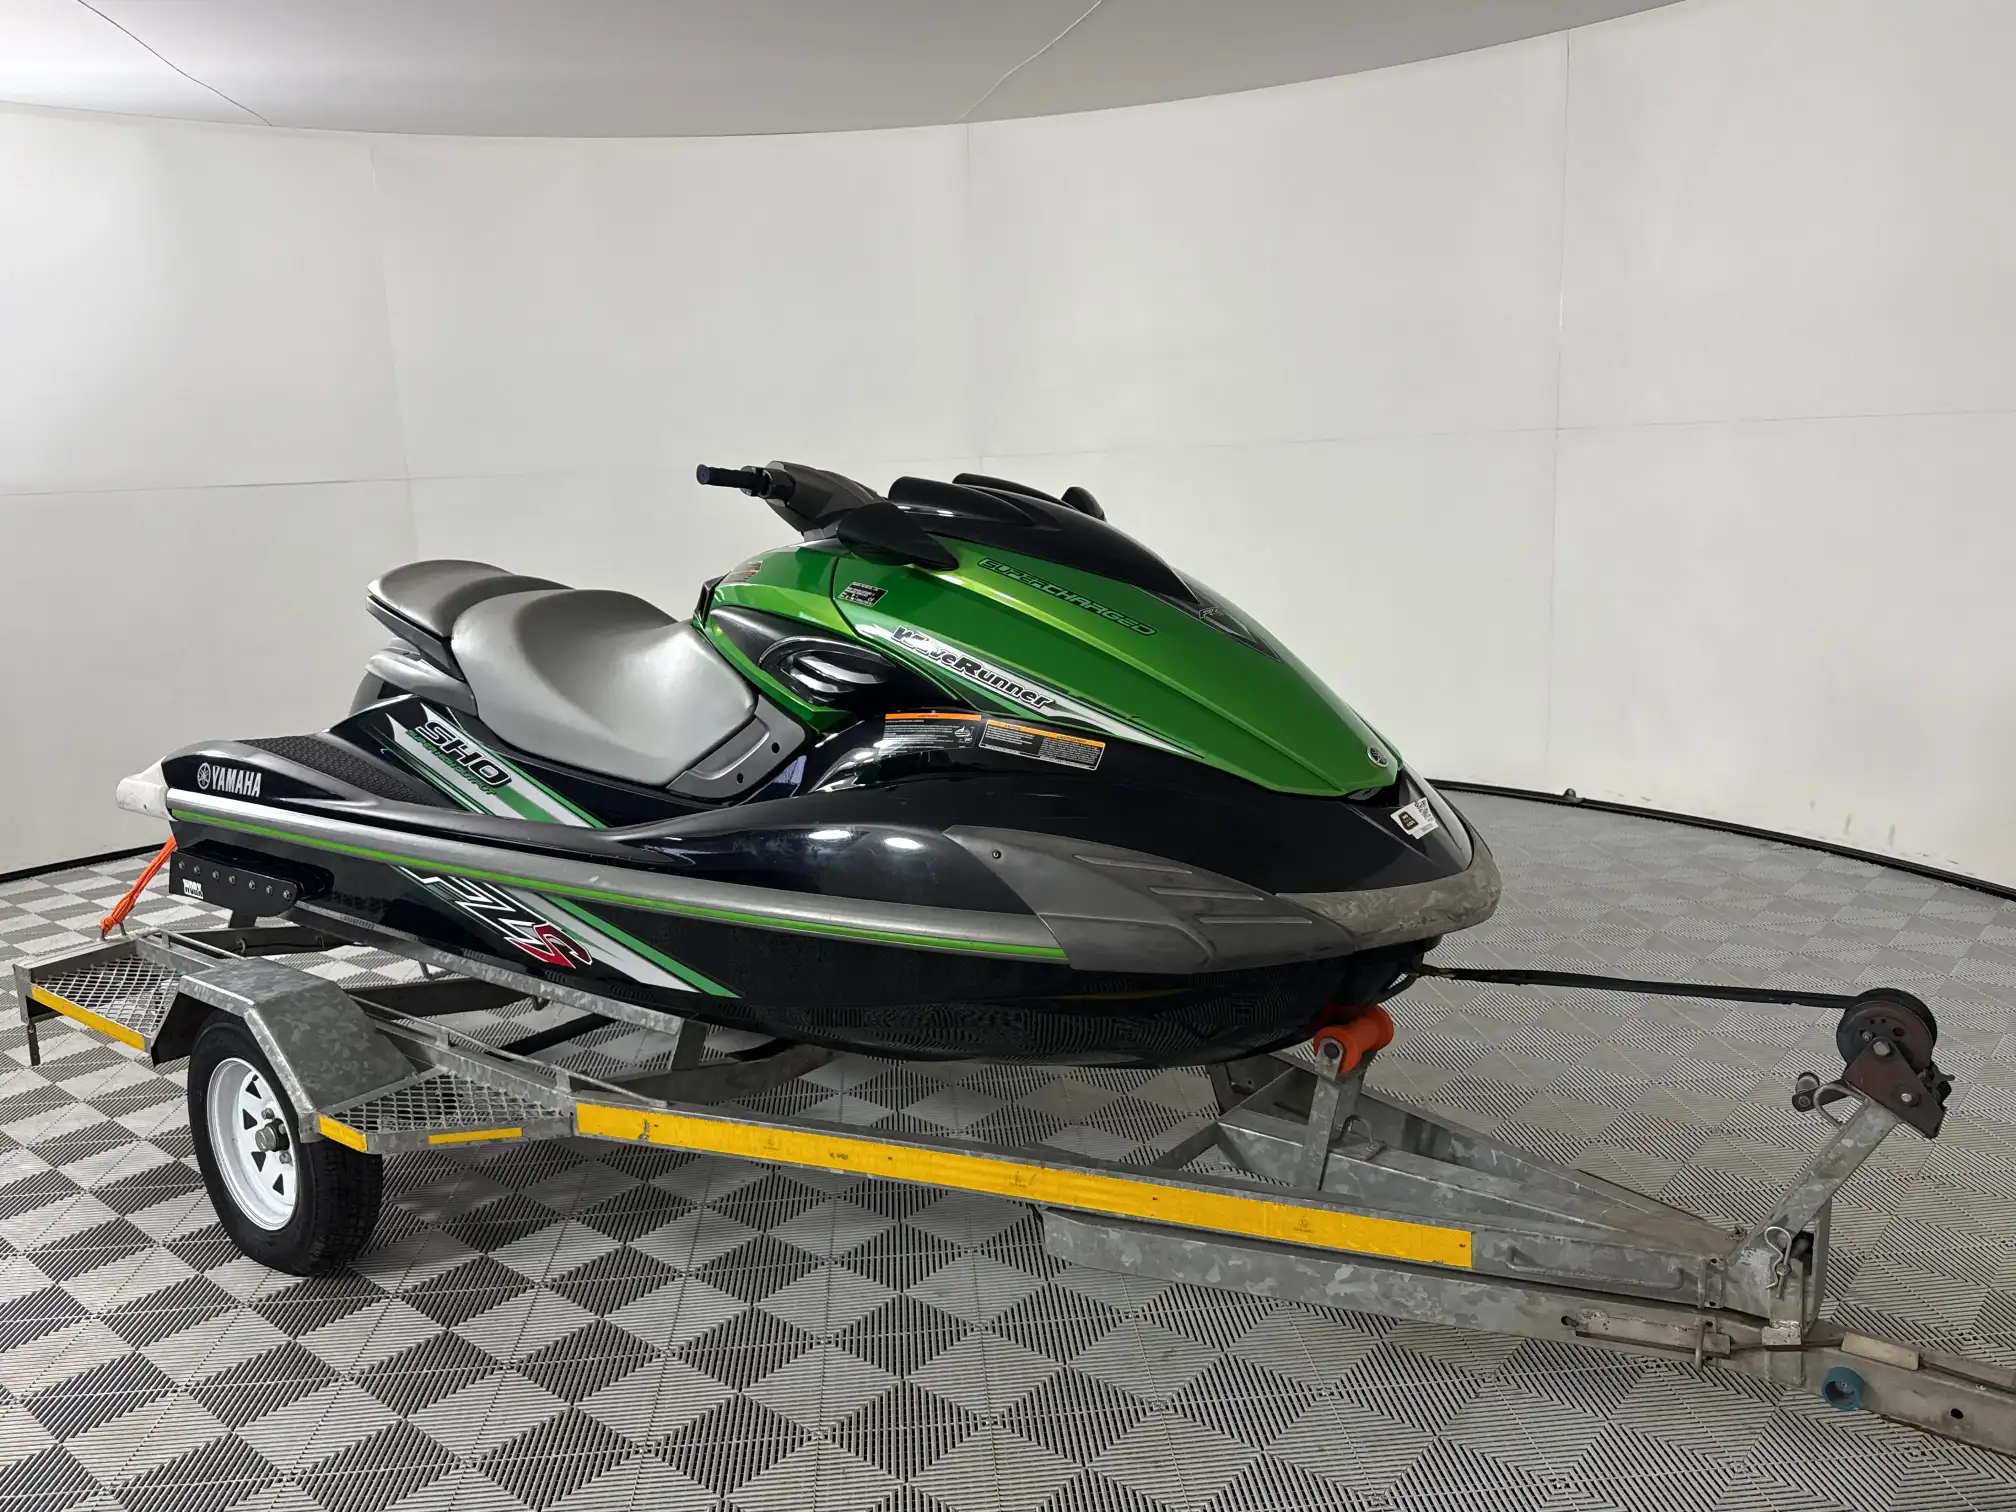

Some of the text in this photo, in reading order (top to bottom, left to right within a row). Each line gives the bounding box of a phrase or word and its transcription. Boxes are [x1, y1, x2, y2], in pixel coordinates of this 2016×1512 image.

[978, 557, 1157, 636] SUPERCHARGED
[212, 765, 262, 797] YAMAHA
[414, 720, 512, 787] SHO
